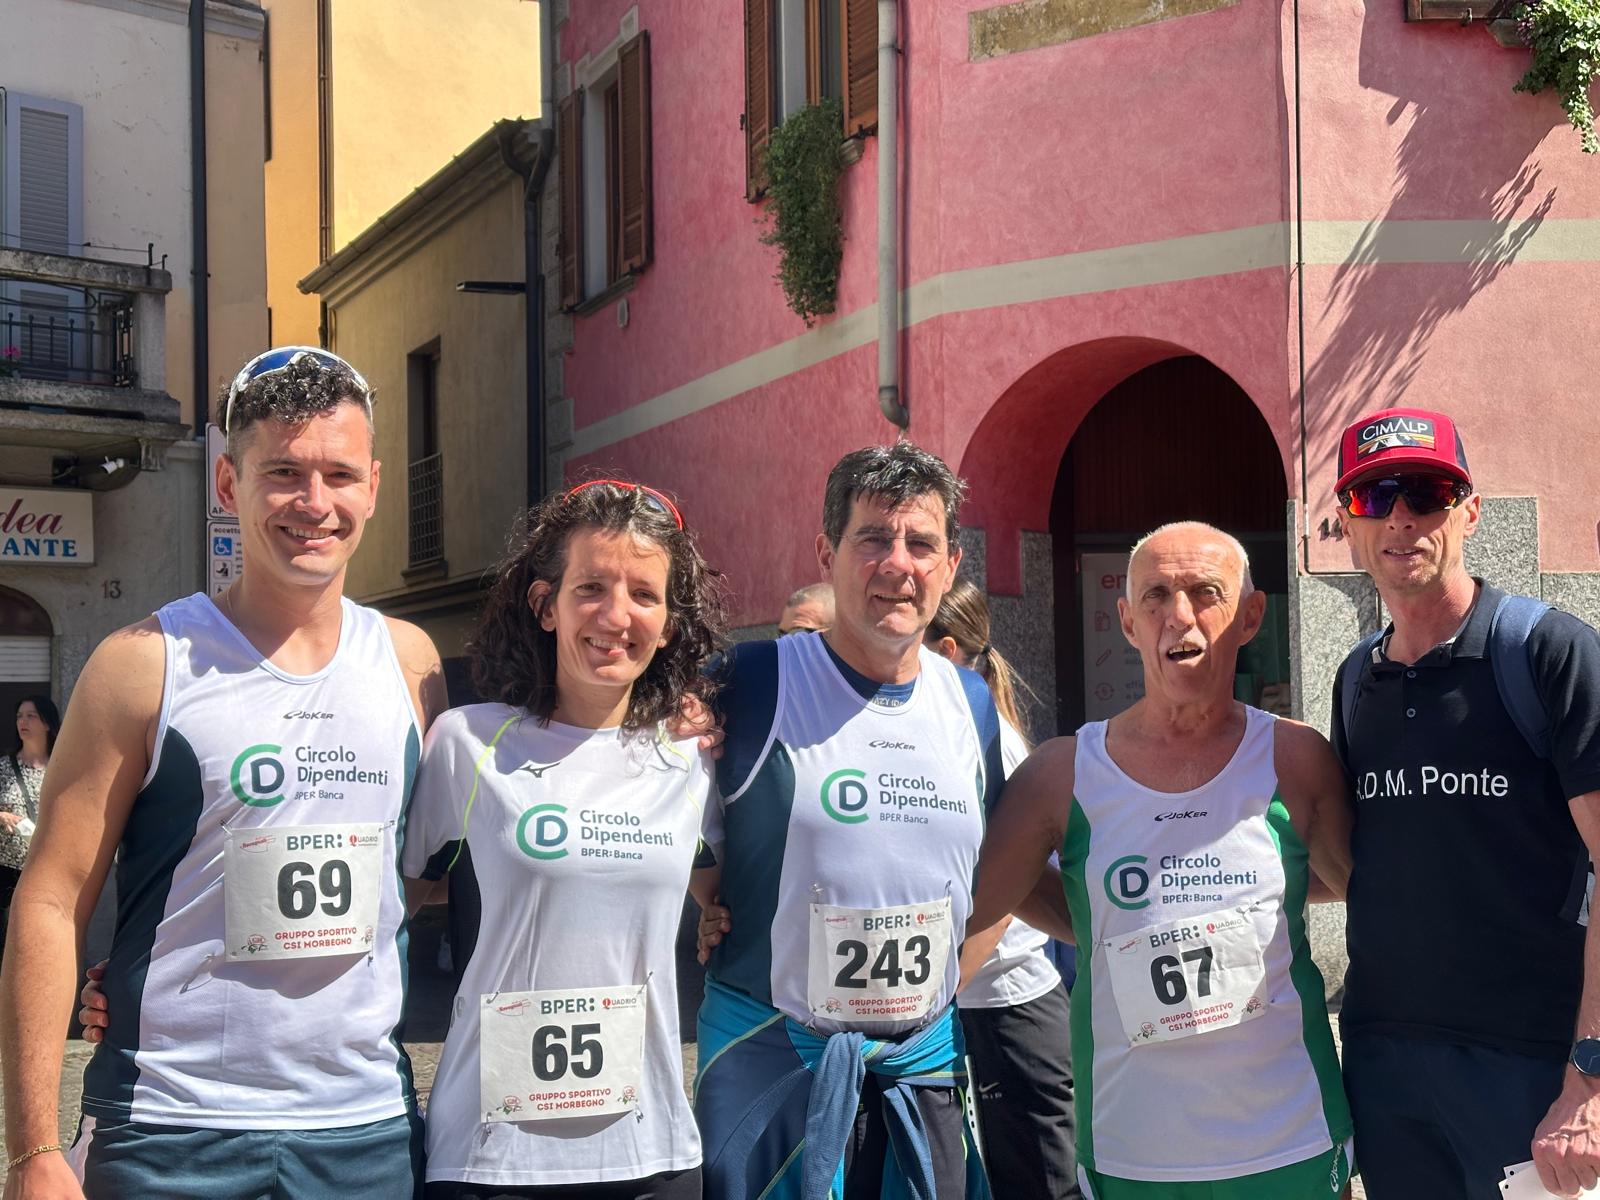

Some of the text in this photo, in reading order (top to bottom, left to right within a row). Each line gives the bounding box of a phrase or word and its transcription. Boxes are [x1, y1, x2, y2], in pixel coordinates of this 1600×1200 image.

[1363, 418, 1428, 440] CIMALP
[2, 537, 78, 557] ANTE
[102, 580, 122, 599] 13
[295, 745, 356, 763] Circolo
[297, 766, 389, 787] Dipendenti
[878, 773, 936, 791] Circolo
[1421, 766, 1509, 797] Ponte
[318, 790, 345, 800] Banca
[879, 790, 967, 814] Dipendenti
[580, 809, 641, 827] Circolo
[880, 812, 929, 824] BPER Banca
[581, 826, 674, 847] Dipendenti
[1159, 853, 1221, 870] Circolo
[277, 859, 352, 919] 69
[1160, 871, 1257, 890] Dipendenti
[275, 930, 315, 940] GRUPPO
[318, 927, 357, 938] SPORTIVO
[283, 938, 352, 950] CSI MORBEGNO
[835, 934, 932, 988] 243
[1150, 946, 1214, 1006] 67
[873, 1005, 917, 1014] MORBEGNO
[885, 995, 923, 1005] SPORTIVO
[1160, 1002, 1234, 1025] GRUPPO SPORTIVO
[1168, 1023, 1183, 1032] CSI
[1185, 1012, 1229, 1028] MORBEGNO
[532, 1023, 604, 1082] 65
[529, 1088, 612, 1101] GRUPPO SPORTIVO
[537, 1098, 605, 1110] CSI MORBEGNO
